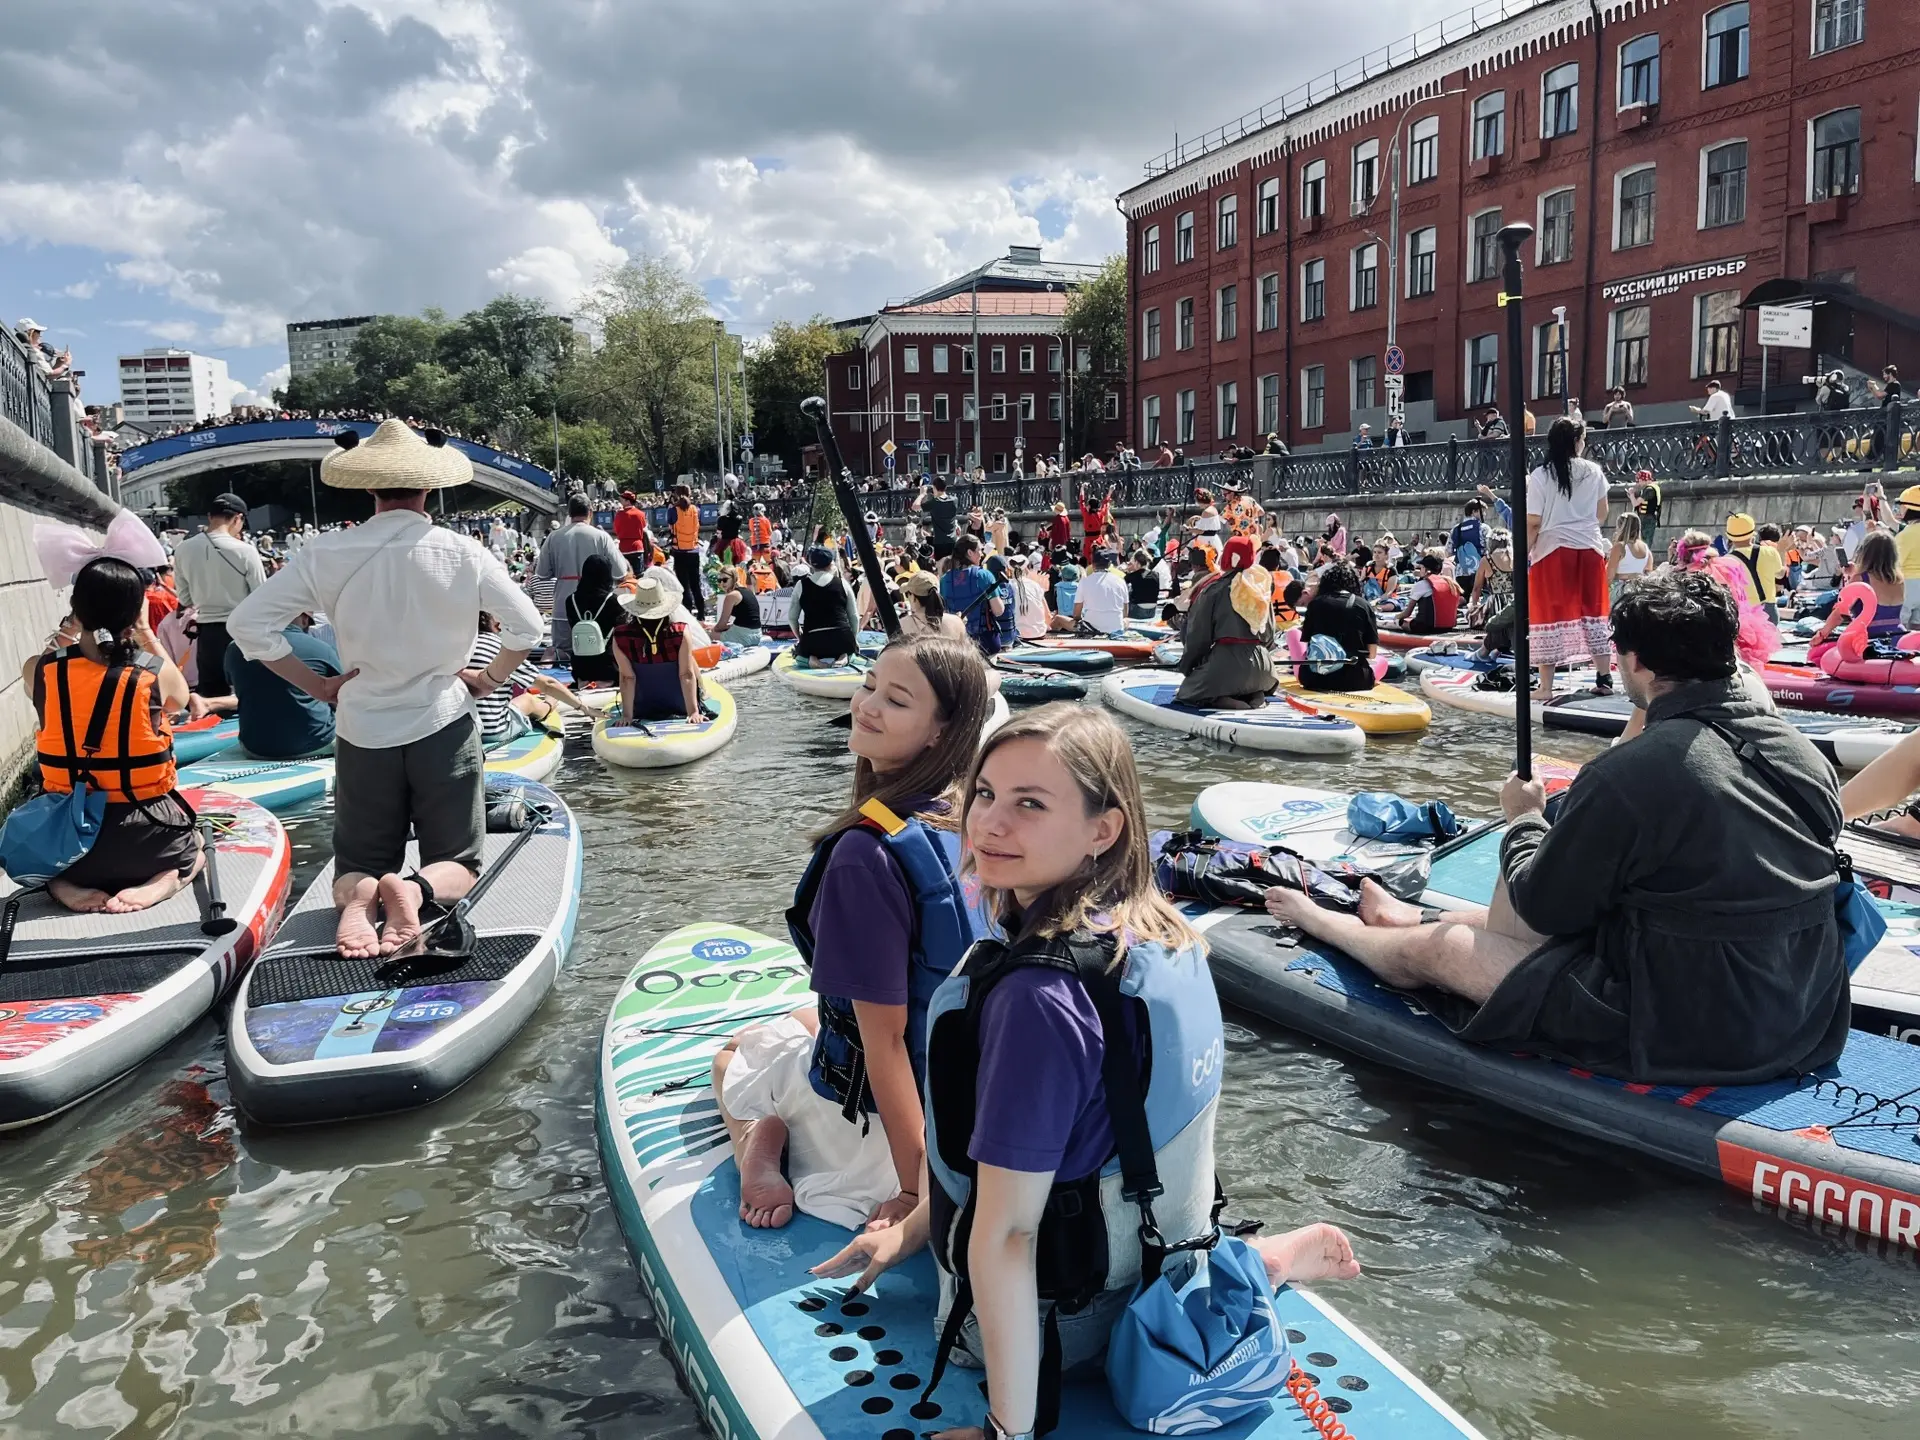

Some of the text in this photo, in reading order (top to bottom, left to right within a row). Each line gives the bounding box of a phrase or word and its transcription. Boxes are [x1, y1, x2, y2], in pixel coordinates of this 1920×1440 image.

[1602, 261, 1747, 298] РУССКИЙ ИНТЕРЬЕР
[1614, 286, 1680, 304] МЕБЕЛЬ ДЕКОР
[190, 432, 217, 443] ЛЕТО
[701, 945, 747, 958] 1488
[635, 963, 807, 995] Ocea
[34, 1011, 92, 1020] 1212
